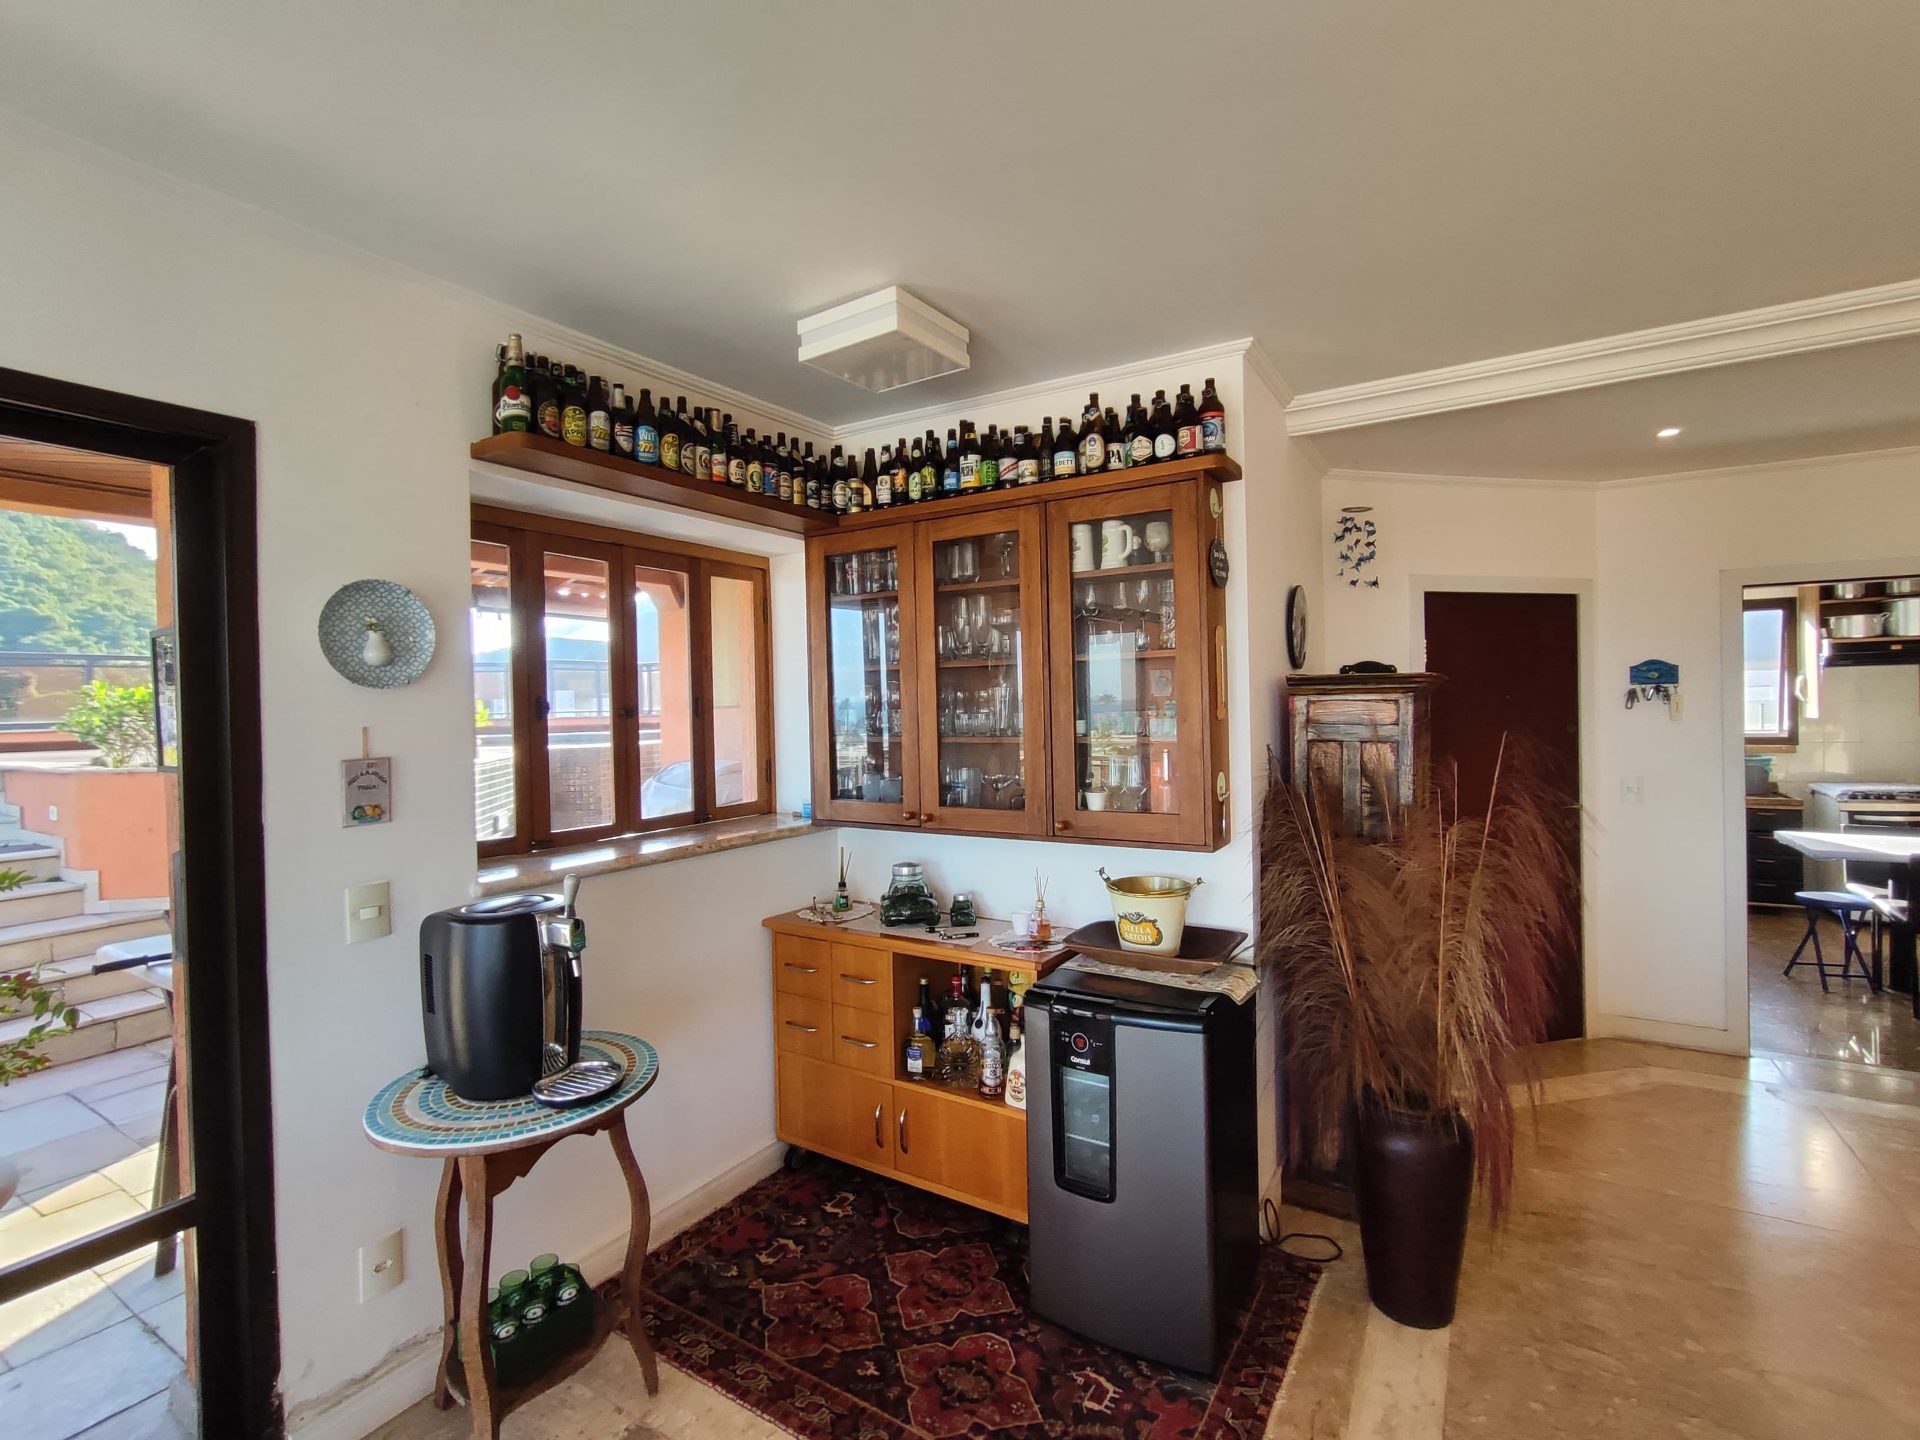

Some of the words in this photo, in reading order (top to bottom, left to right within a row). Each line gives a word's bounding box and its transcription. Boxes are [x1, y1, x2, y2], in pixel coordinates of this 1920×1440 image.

[638, 430, 656, 442] WIT
[1055, 459, 1074, 467] EDETT
[1122, 924, 1152, 934] STELLA
[1121, 932, 1153, 942] ARTOIS
[1070, 1055, 1091, 1066] Consul
